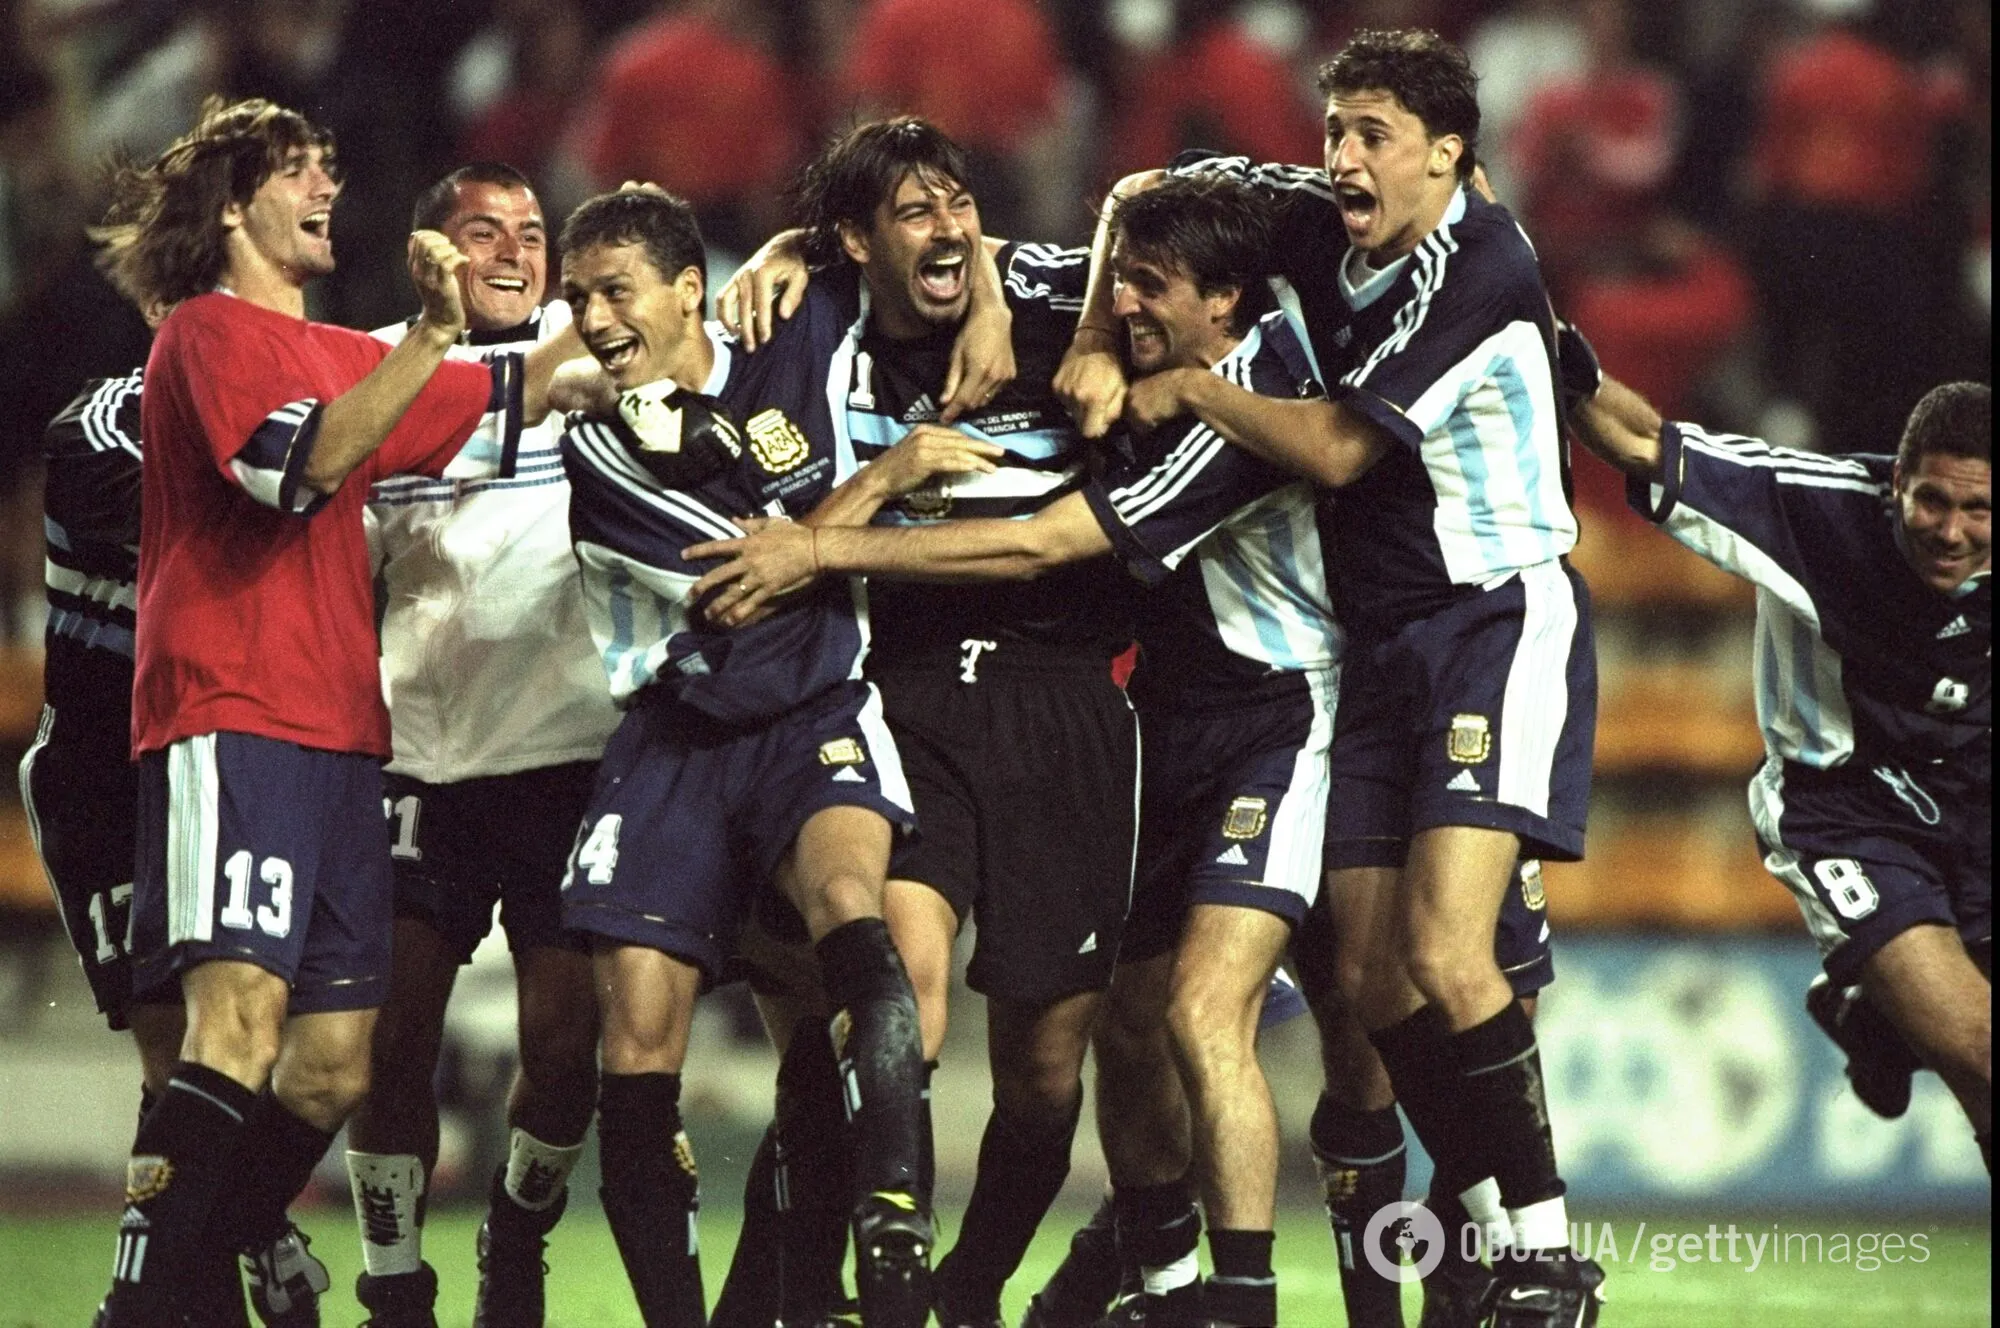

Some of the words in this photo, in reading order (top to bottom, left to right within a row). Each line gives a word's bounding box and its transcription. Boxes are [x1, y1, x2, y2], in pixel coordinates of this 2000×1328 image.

[849, 351, 875, 410] 1
[220, 850, 293, 938] 13
[1813, 858, 1880, 920] 8
